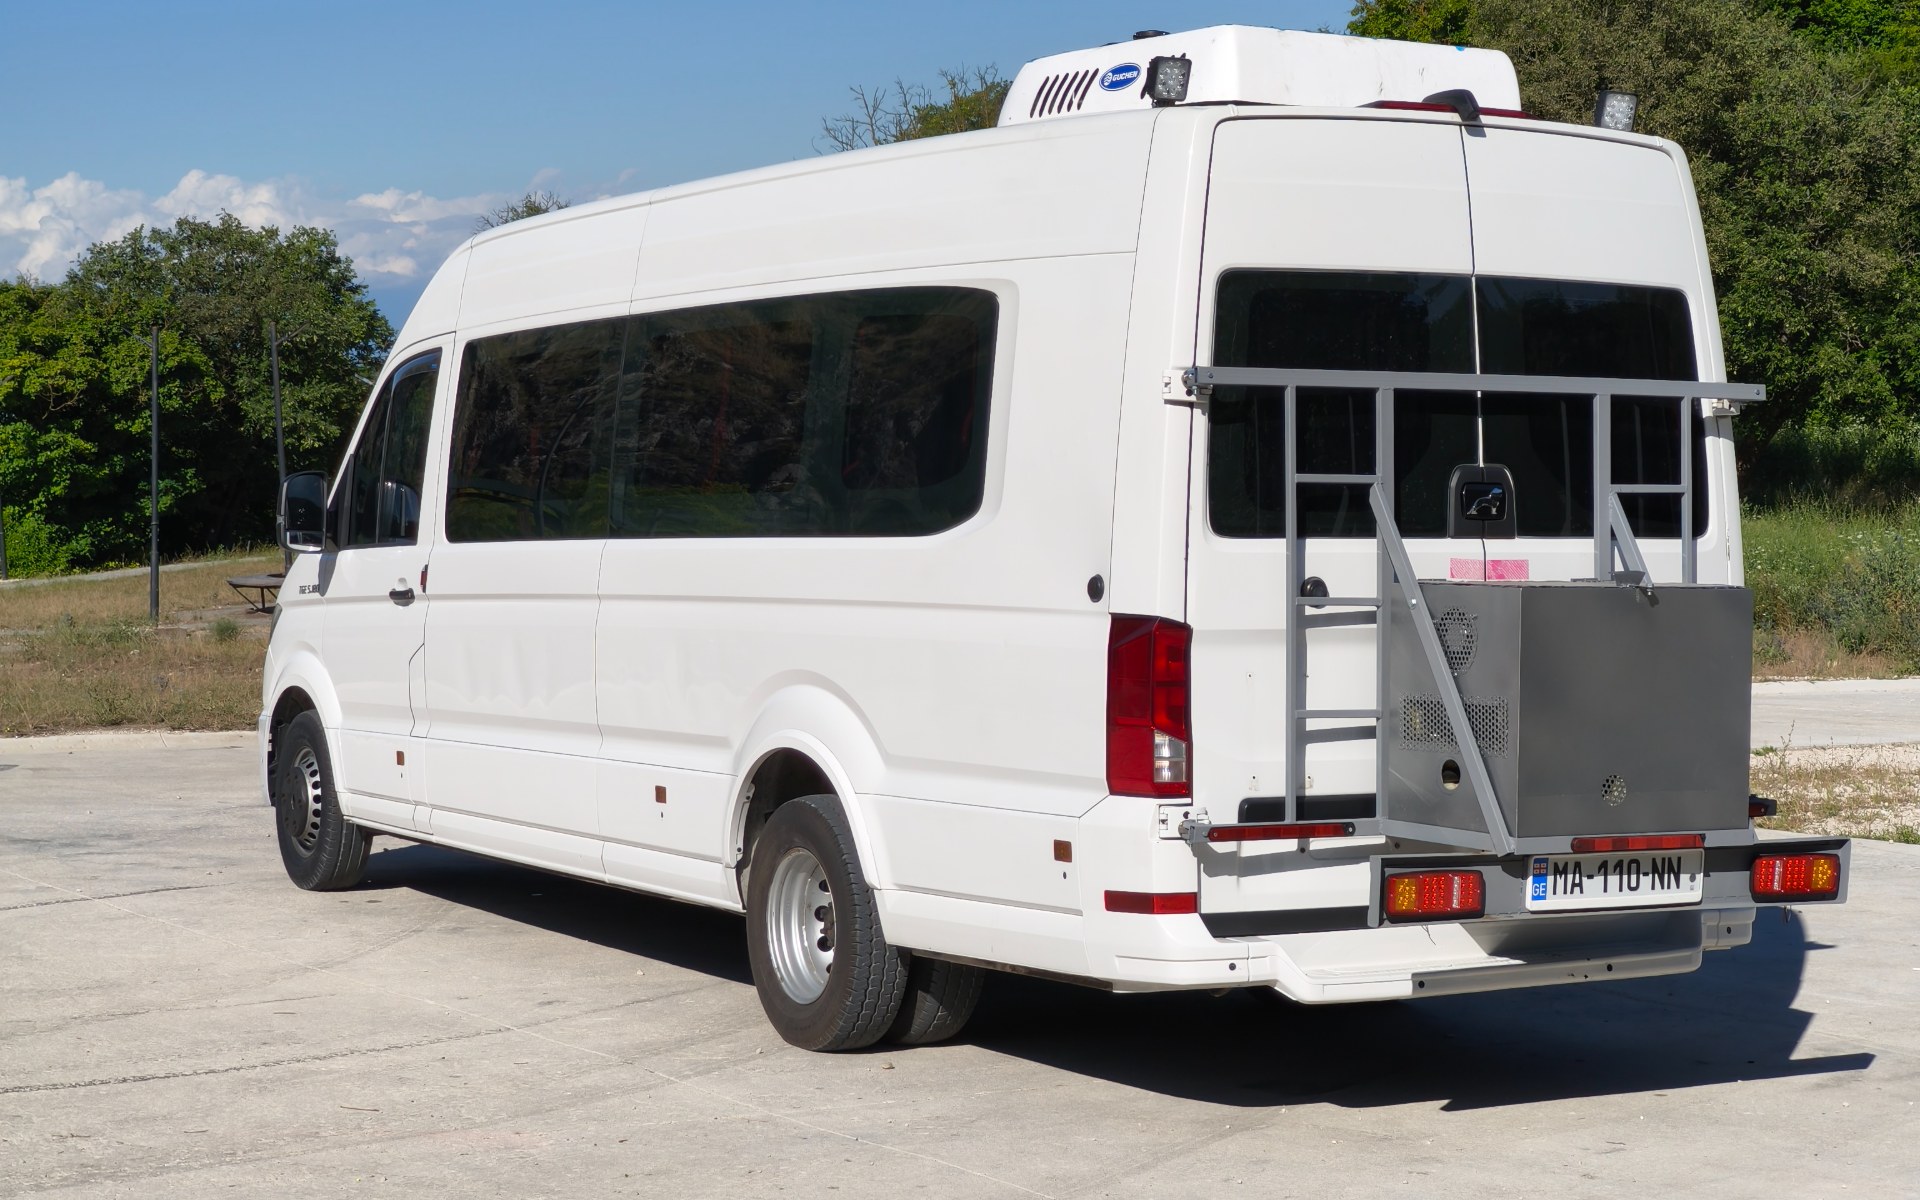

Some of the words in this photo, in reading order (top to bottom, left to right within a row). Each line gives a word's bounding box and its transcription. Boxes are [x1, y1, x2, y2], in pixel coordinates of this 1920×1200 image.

[1112, 70, 1138, 81] GUCHEN
[1552, 856, 1682, 895] MA-110-NN
[1532, 883, 1546, 896] GE
